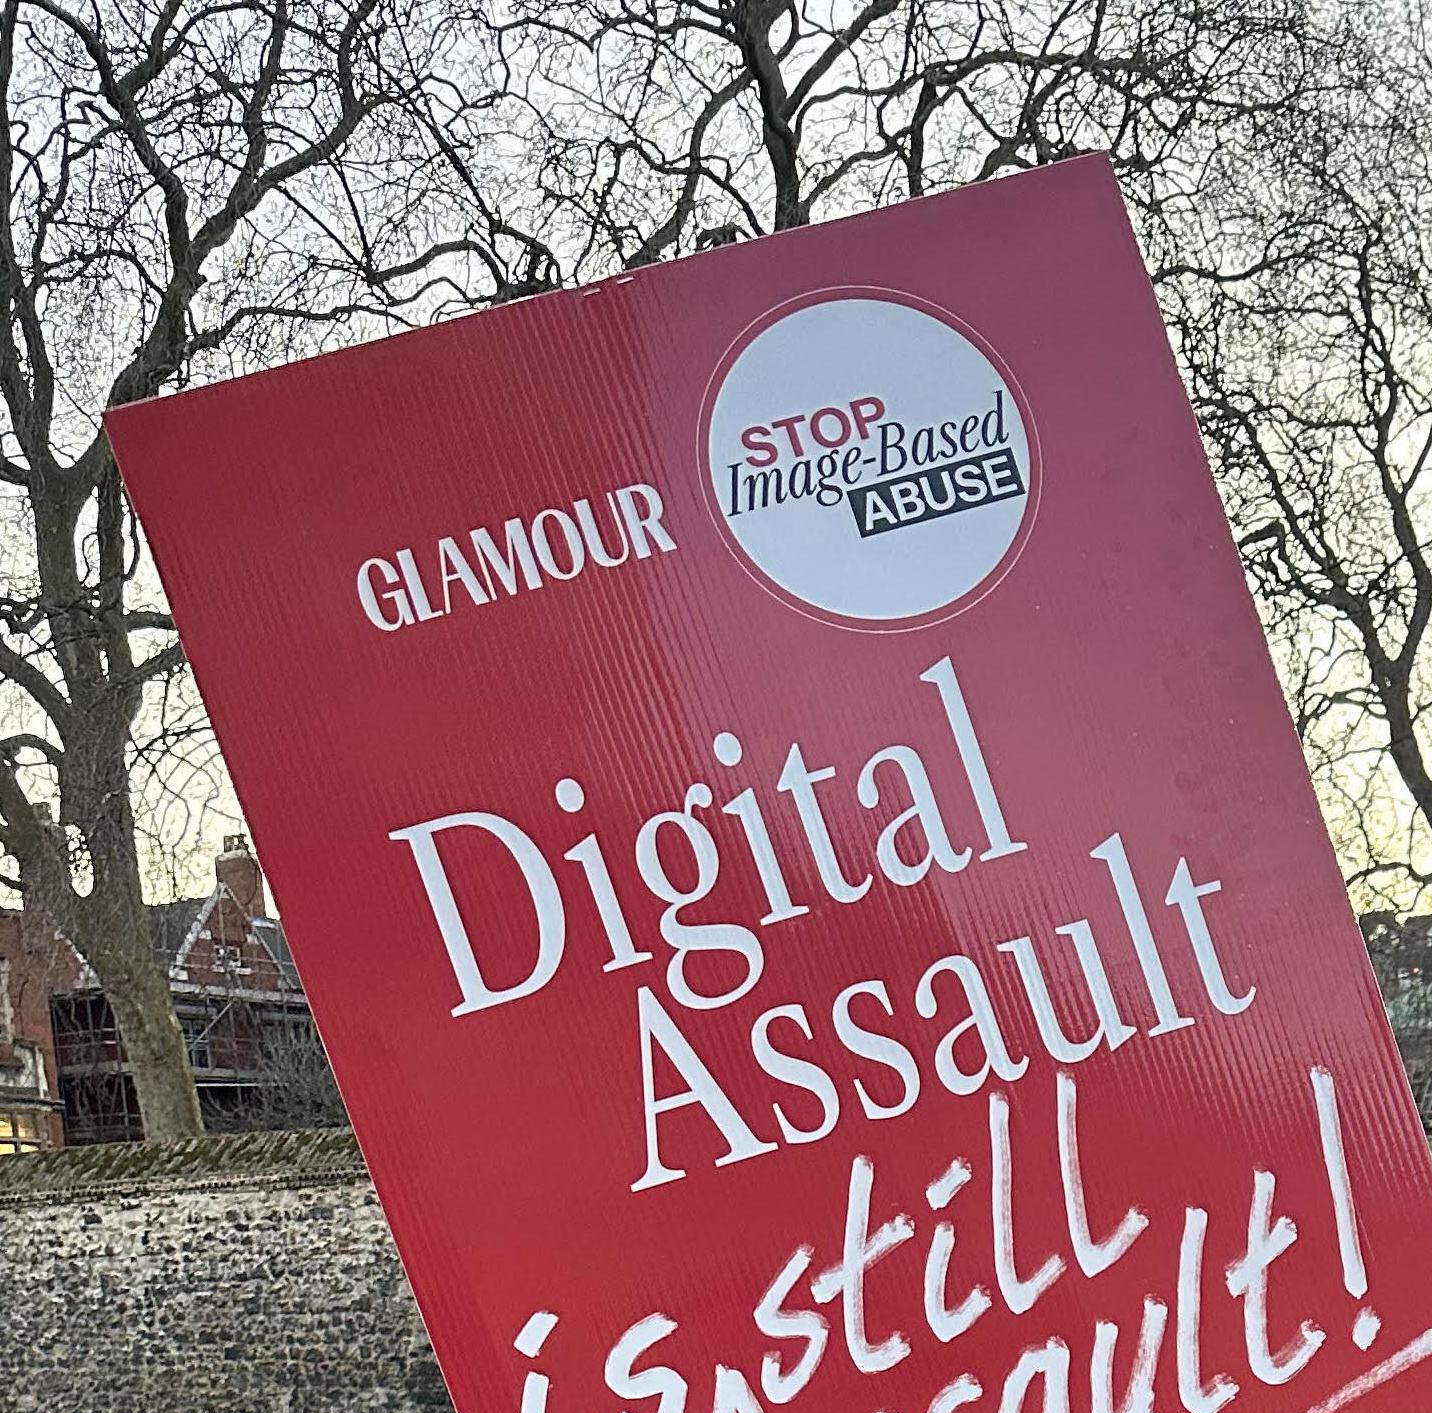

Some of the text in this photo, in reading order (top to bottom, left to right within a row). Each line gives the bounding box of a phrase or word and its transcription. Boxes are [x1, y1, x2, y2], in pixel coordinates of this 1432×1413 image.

[727, 389, 1010, 517] Image-Based
[740, 395, 886, 468] STOP
[864, 455, 1019, 531] ABUSE
[355, 482, 679, 633] GLAMOUR
[388, 655, 1030, 1018] Digital
[630, 831, 1257, 1194] Assault
[753, 1071, 1150, 1405] still
